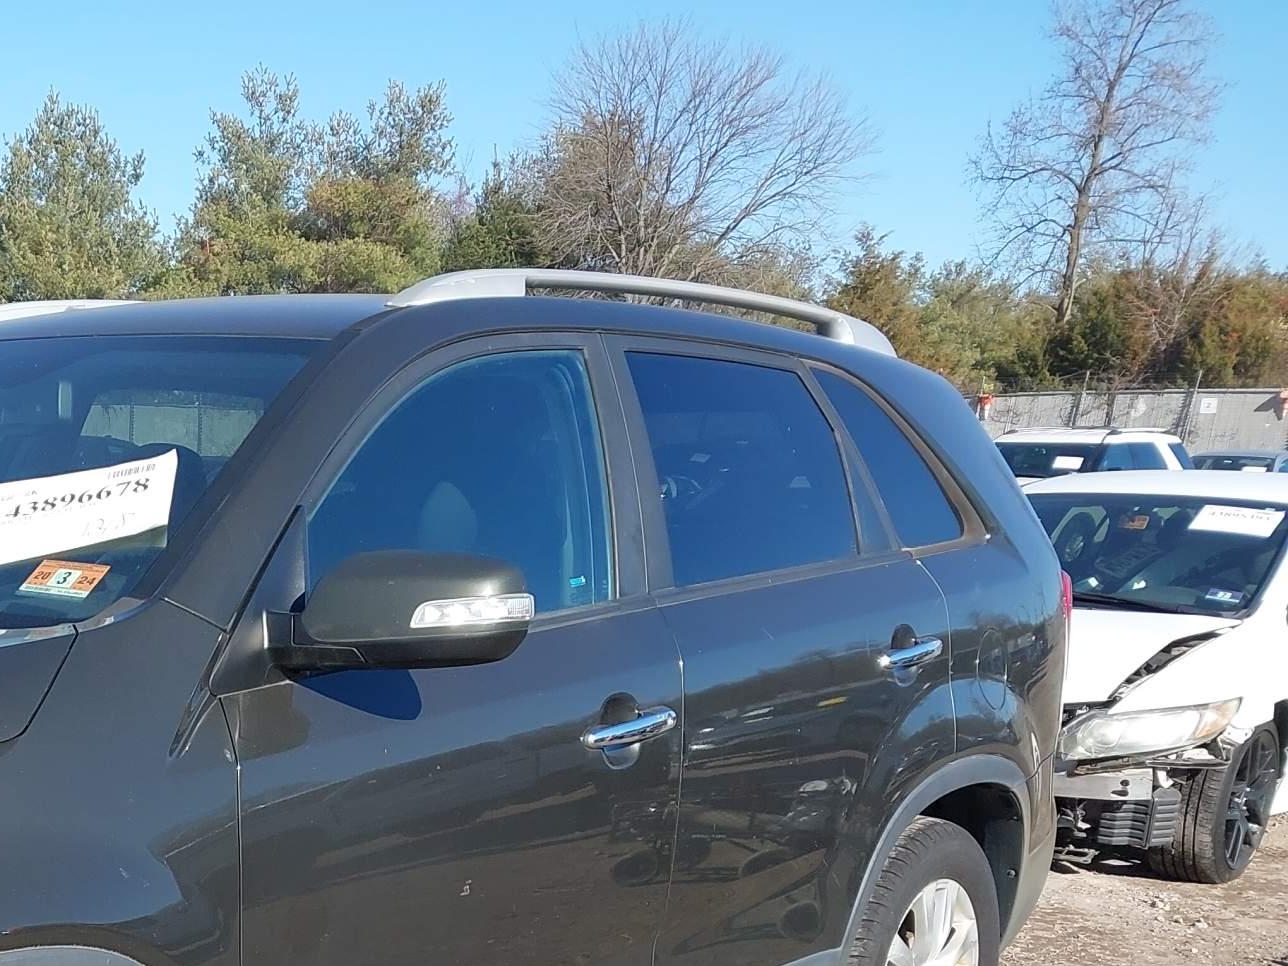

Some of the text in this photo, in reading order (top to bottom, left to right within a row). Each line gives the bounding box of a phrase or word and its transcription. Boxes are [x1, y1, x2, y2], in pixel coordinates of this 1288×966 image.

[4, 476, 151, 519] 43896678
[33, 570, 97, 586] 20 3 24
